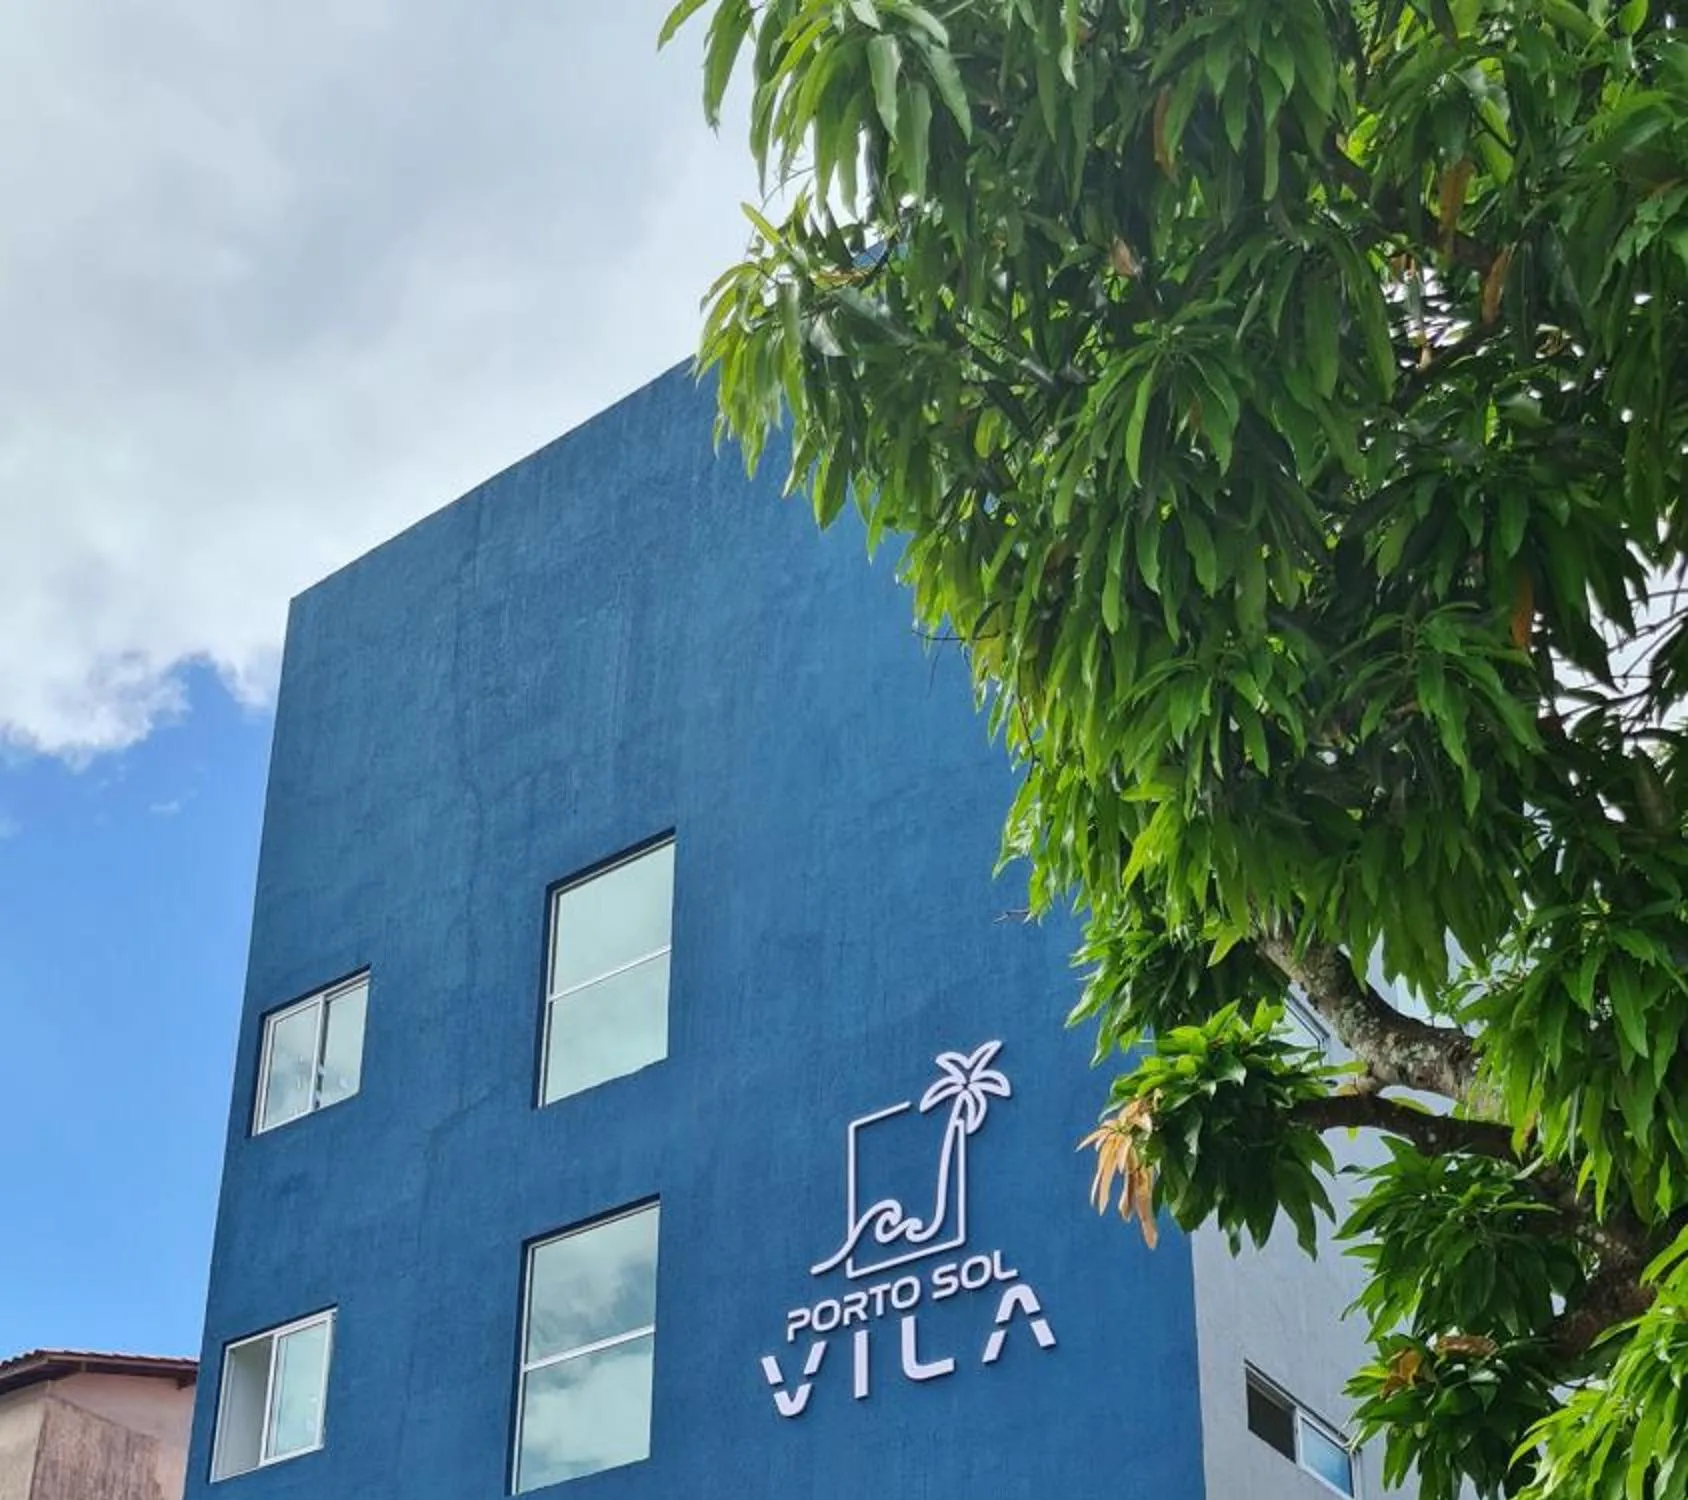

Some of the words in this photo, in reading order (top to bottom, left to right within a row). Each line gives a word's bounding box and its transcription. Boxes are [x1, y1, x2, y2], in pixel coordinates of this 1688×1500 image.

[761, 1284, 1056, 1417] VILA
[787, 1276, 921, 1342] PORTO
[932, 1250, 1018, 1299] SOL
